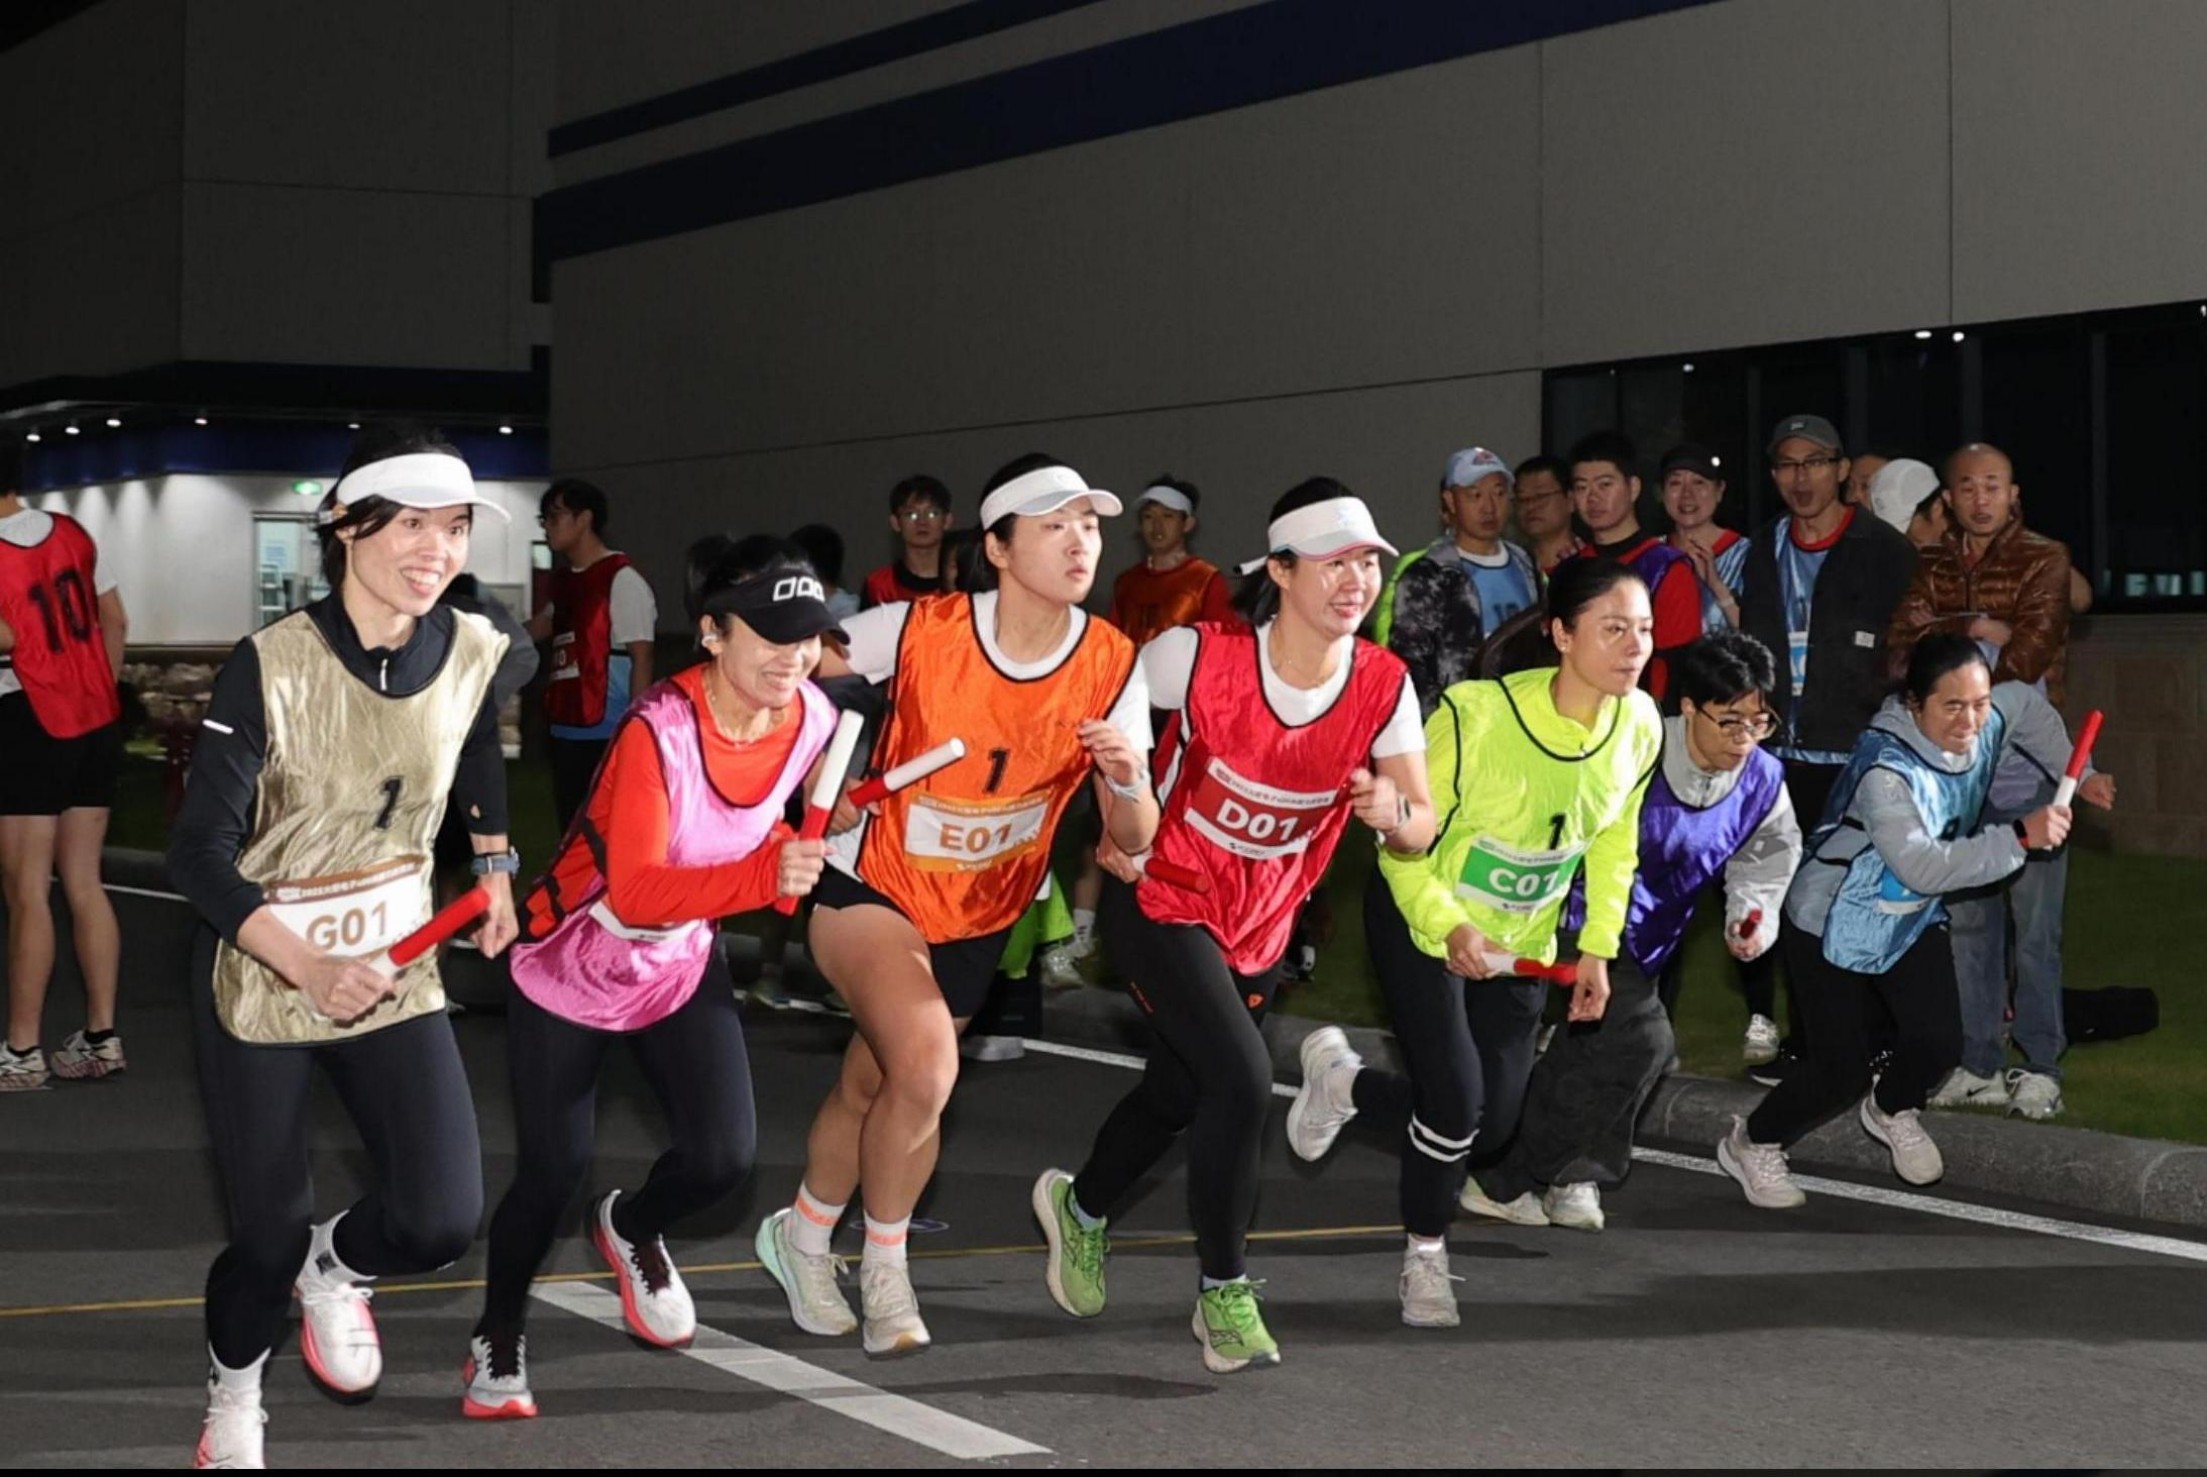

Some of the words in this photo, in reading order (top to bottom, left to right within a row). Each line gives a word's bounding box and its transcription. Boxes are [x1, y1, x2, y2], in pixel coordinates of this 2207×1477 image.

[28, 568, 91, 653] 10
[981, 749, 1010, 795] 1
[373, 774, 403, 831] 1
[1216, 797, 1299, 840] D01
[940, 822, 1013, 854] E01
[1547, 812, 1566, 851] 1
[1488, 867, 1560, 897] C01
[306, 900, 387, 950] G01
